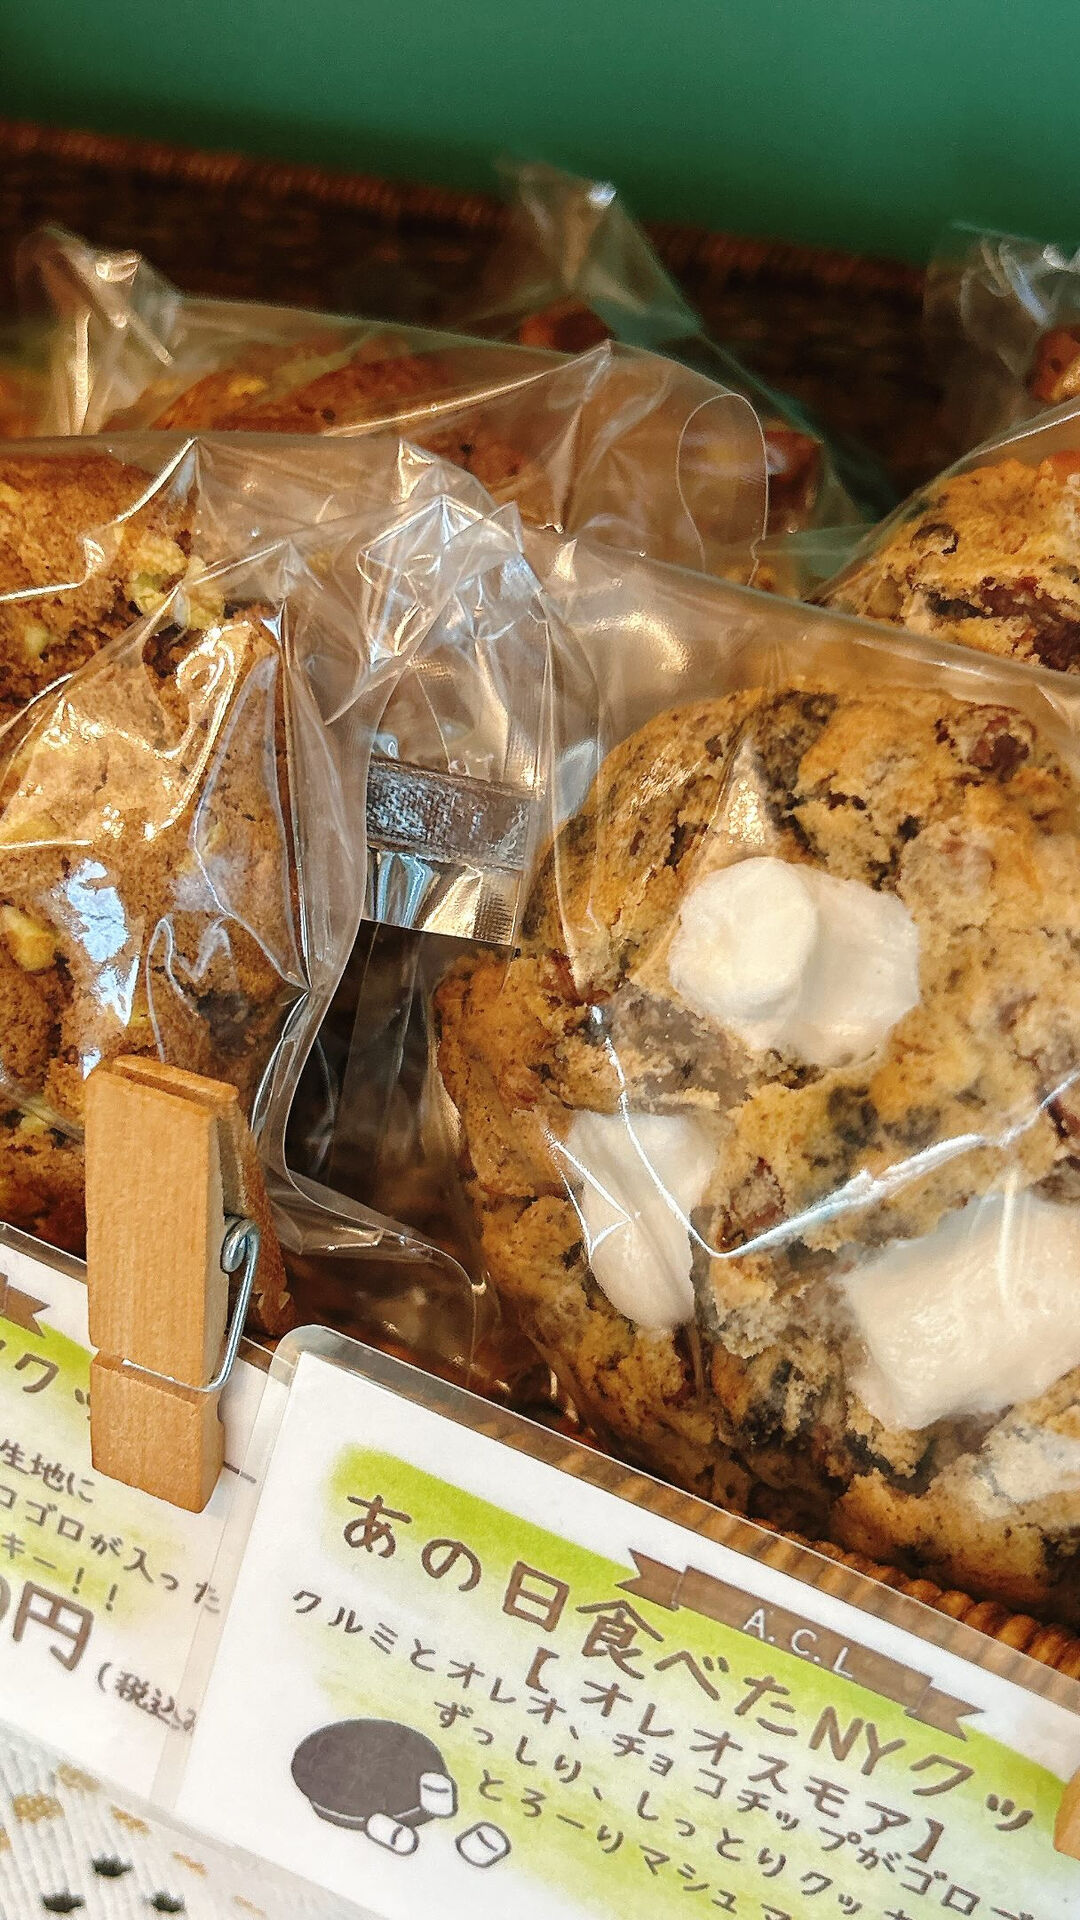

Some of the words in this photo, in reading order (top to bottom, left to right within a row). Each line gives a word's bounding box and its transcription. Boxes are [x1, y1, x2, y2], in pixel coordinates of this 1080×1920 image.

[0, 1438, 95, 1504] 生地に
[343, 1494, 1035, 1833] あの日食べたNYクッ
[525, 1646, 945, 1864] 【オレオスモア】
